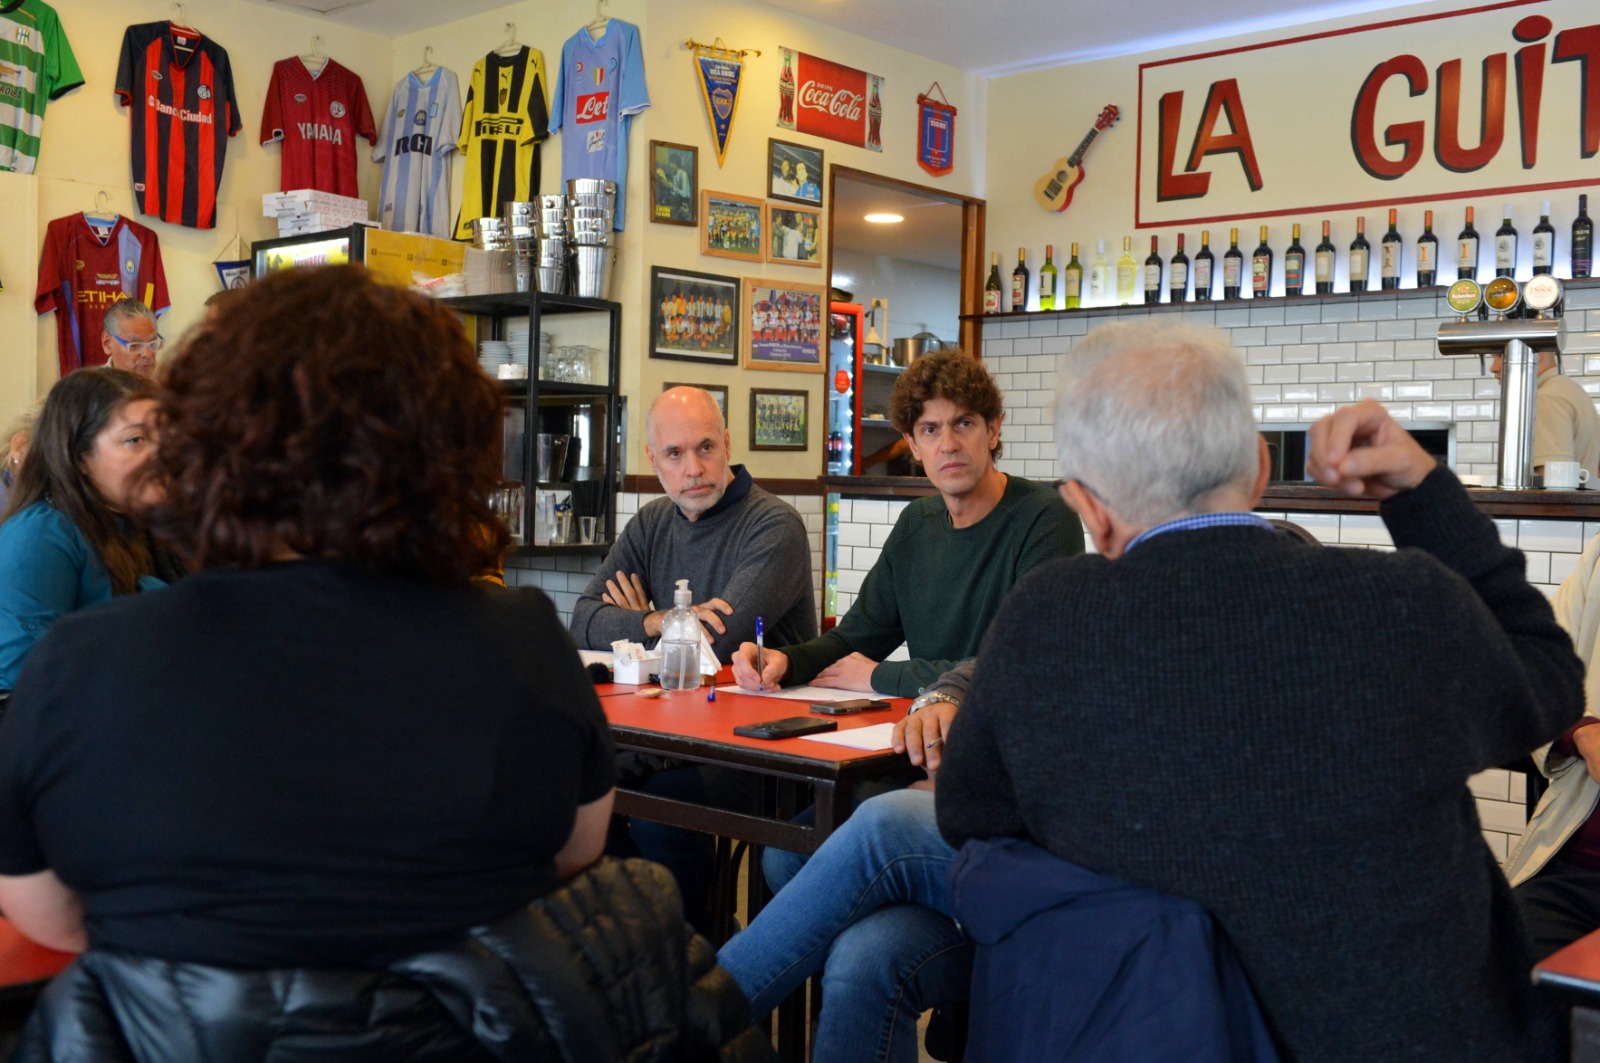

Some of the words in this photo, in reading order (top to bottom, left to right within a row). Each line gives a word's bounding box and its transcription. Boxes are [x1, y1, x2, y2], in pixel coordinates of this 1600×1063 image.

[180, 109, 212, 124] Ciudad
[1157, 78, 1263, 202] LA
[78, 290, 134, 303] ETIHA
